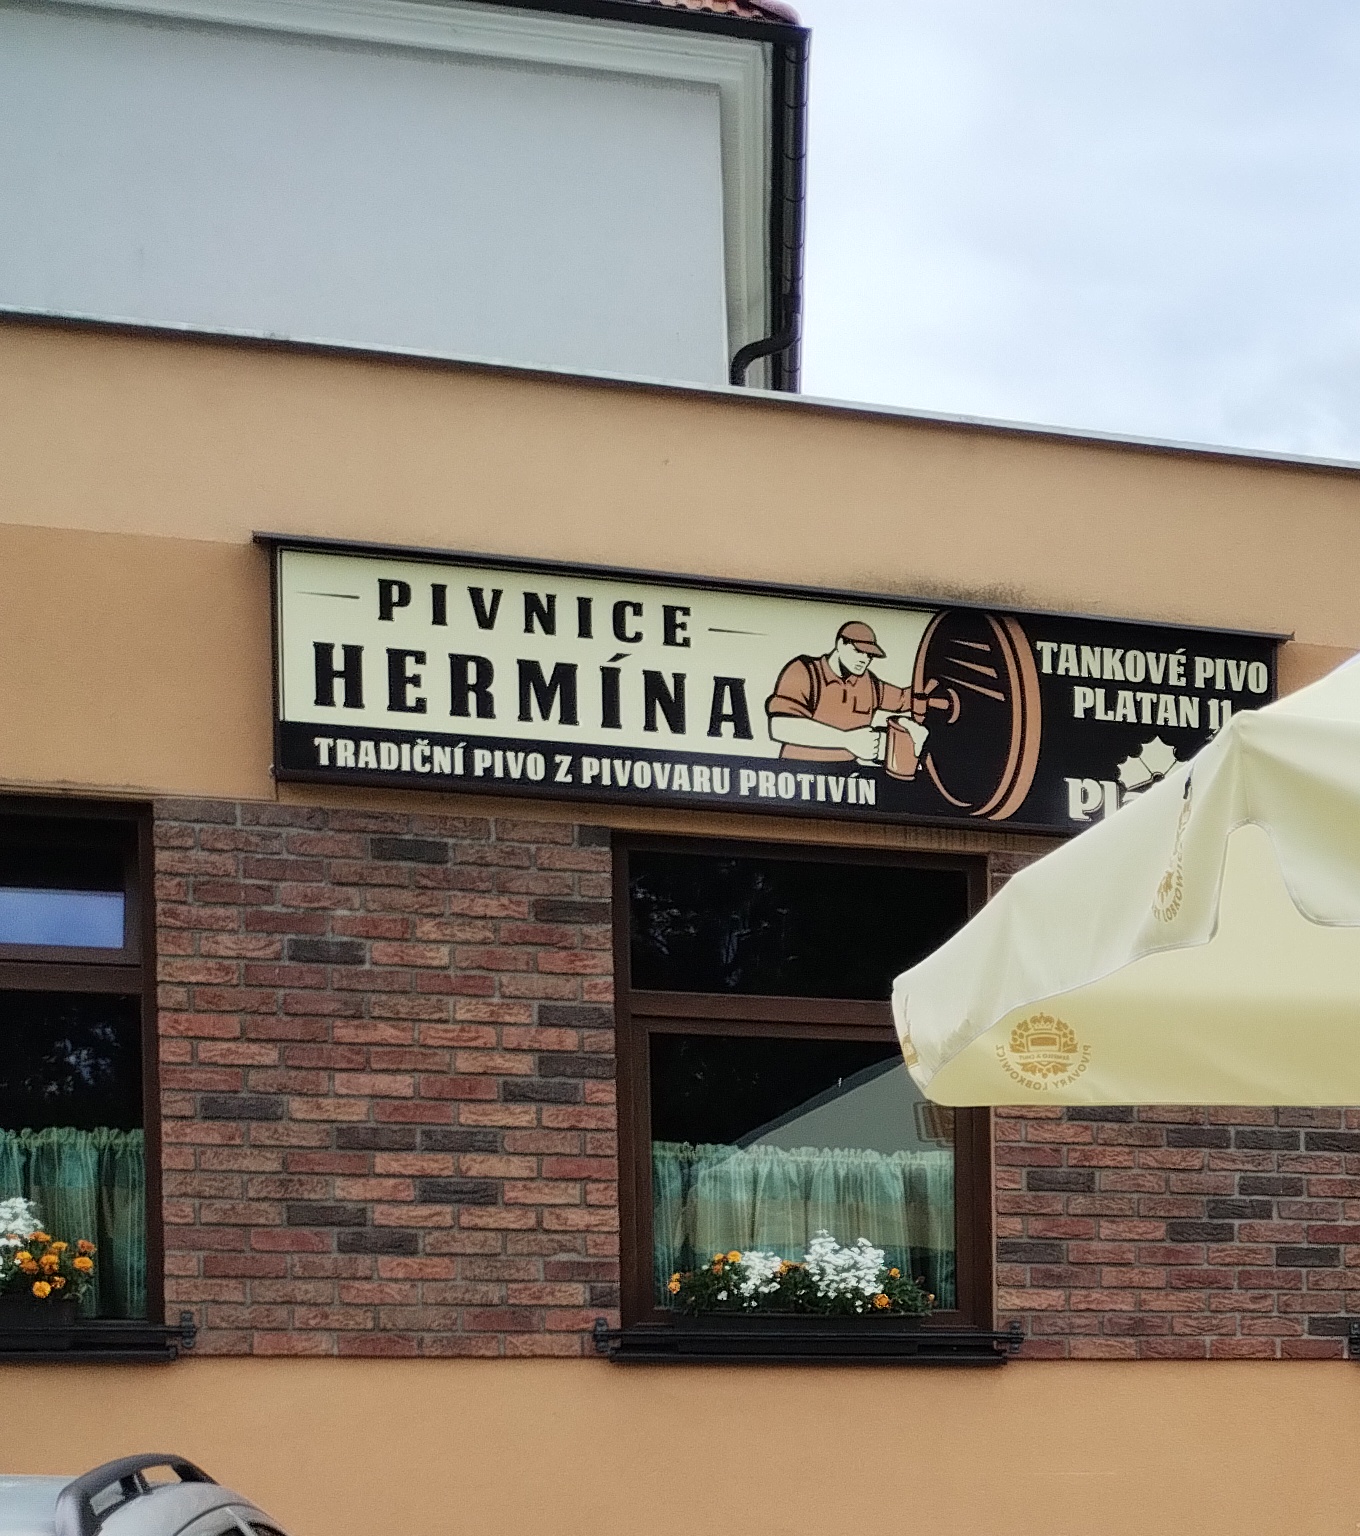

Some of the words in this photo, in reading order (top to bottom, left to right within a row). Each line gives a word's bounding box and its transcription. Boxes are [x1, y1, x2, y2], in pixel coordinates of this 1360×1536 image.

[378, 578, 691, 648] PIVNICE
[312, 642, 753, 740] HERMÍNA
[1037, 641, 1188, 687] TANKOVÉ
[1195, 656, 1269, 694] PIVO
[1073, 686, 1200, 729] PLATAN
[313, 736, 467, 776] TRADIČNÍ
[474, 749, 545, 781] PIVO
[555, 755, 573, 783] Z
[582, 756, 730, 795] PIVOVARU
[740, 770, 877, 806] PROTIVÍN
